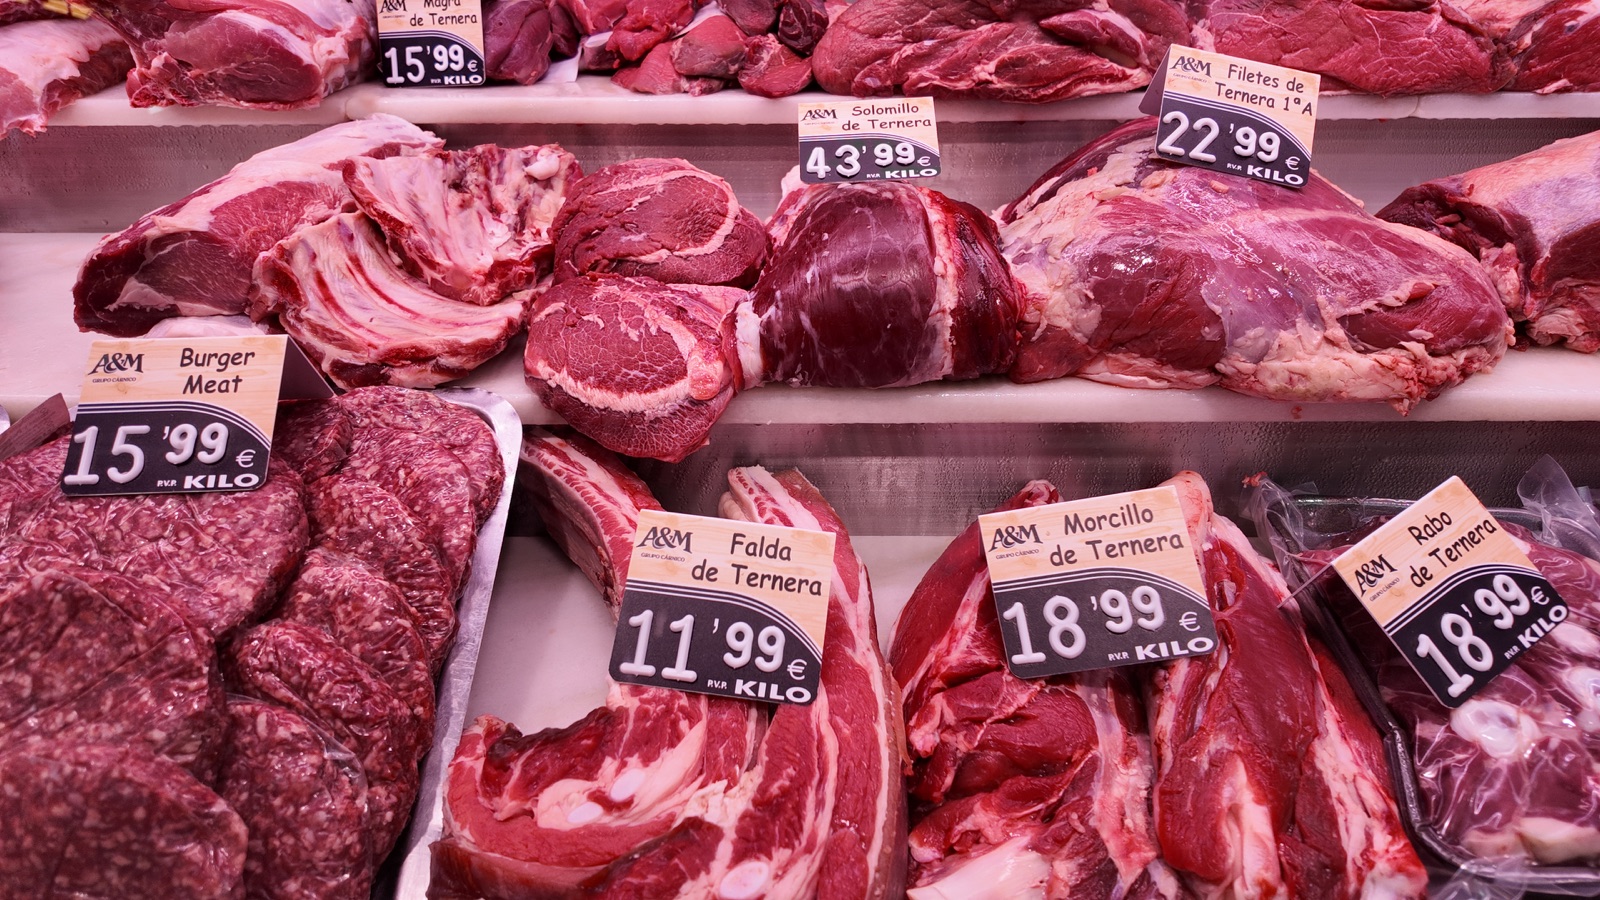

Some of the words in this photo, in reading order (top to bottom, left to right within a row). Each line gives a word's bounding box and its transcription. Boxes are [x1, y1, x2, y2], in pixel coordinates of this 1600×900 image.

[379, 0, 408, 14] A&M
[424, 0, 461, 11] Magra
[410, 14, 424, 26] de
[429, 13, 478, 25] Ternera
[467, 60, 478, 72] €
[1169, 56, 1212, 78] A&M
[444, 75, 482, 85] KILO
[1227, 63, 1279, 88] Filetes
[1286, 77, 1304, 93] de
[1215, 82, 1275, 109] Ternera
[801, 108, 838, 121] A&M
[852, 103, 919, 116] Solomillo
[841, 120, 860, 131] de
[867, 119, 931, 129] Ternera
[917, 156, 931, 166] €
[1285, 156, 1300, 171] €
[885, 168, 937, 179] KILO
[1247, 164, 1304, 185] KILO
[88, 352, 145, 375] A&M
[179, 347, 255, 372] Burger
[182, 375, 243, 394] Meat
[236, 449, 256, 468] €
[183, 473, 259, 490] KILO
[1064, 503, 1154, 536] Morcillo
[1407, 510, 1452, 546] Rabo
[636, 526, 693, 554] A&M
[730, 532, 792, 562] Falda
[988, 524, 1044, 552] A&M
[1050, 544, 1078, 566] de
[1085, 533, 1184, 560] Ternera
[1410, 565, 1433, 588] de
[1428, 518, 1497, 568] Ternera
[691, 559, 719, 582] de
[731, 563, 822, 596] Ternera
[1355, 554, 1398, 597] A&M
[1530, 586, 1550, 606] €
[1179, 611, 1200, 632] €
[1517, 604, 1568, 649] KILO
[1135, 637, 1214, 660] KILO
[787, 659, 807, 680] €
[734, 678, 811, 703] KILO
